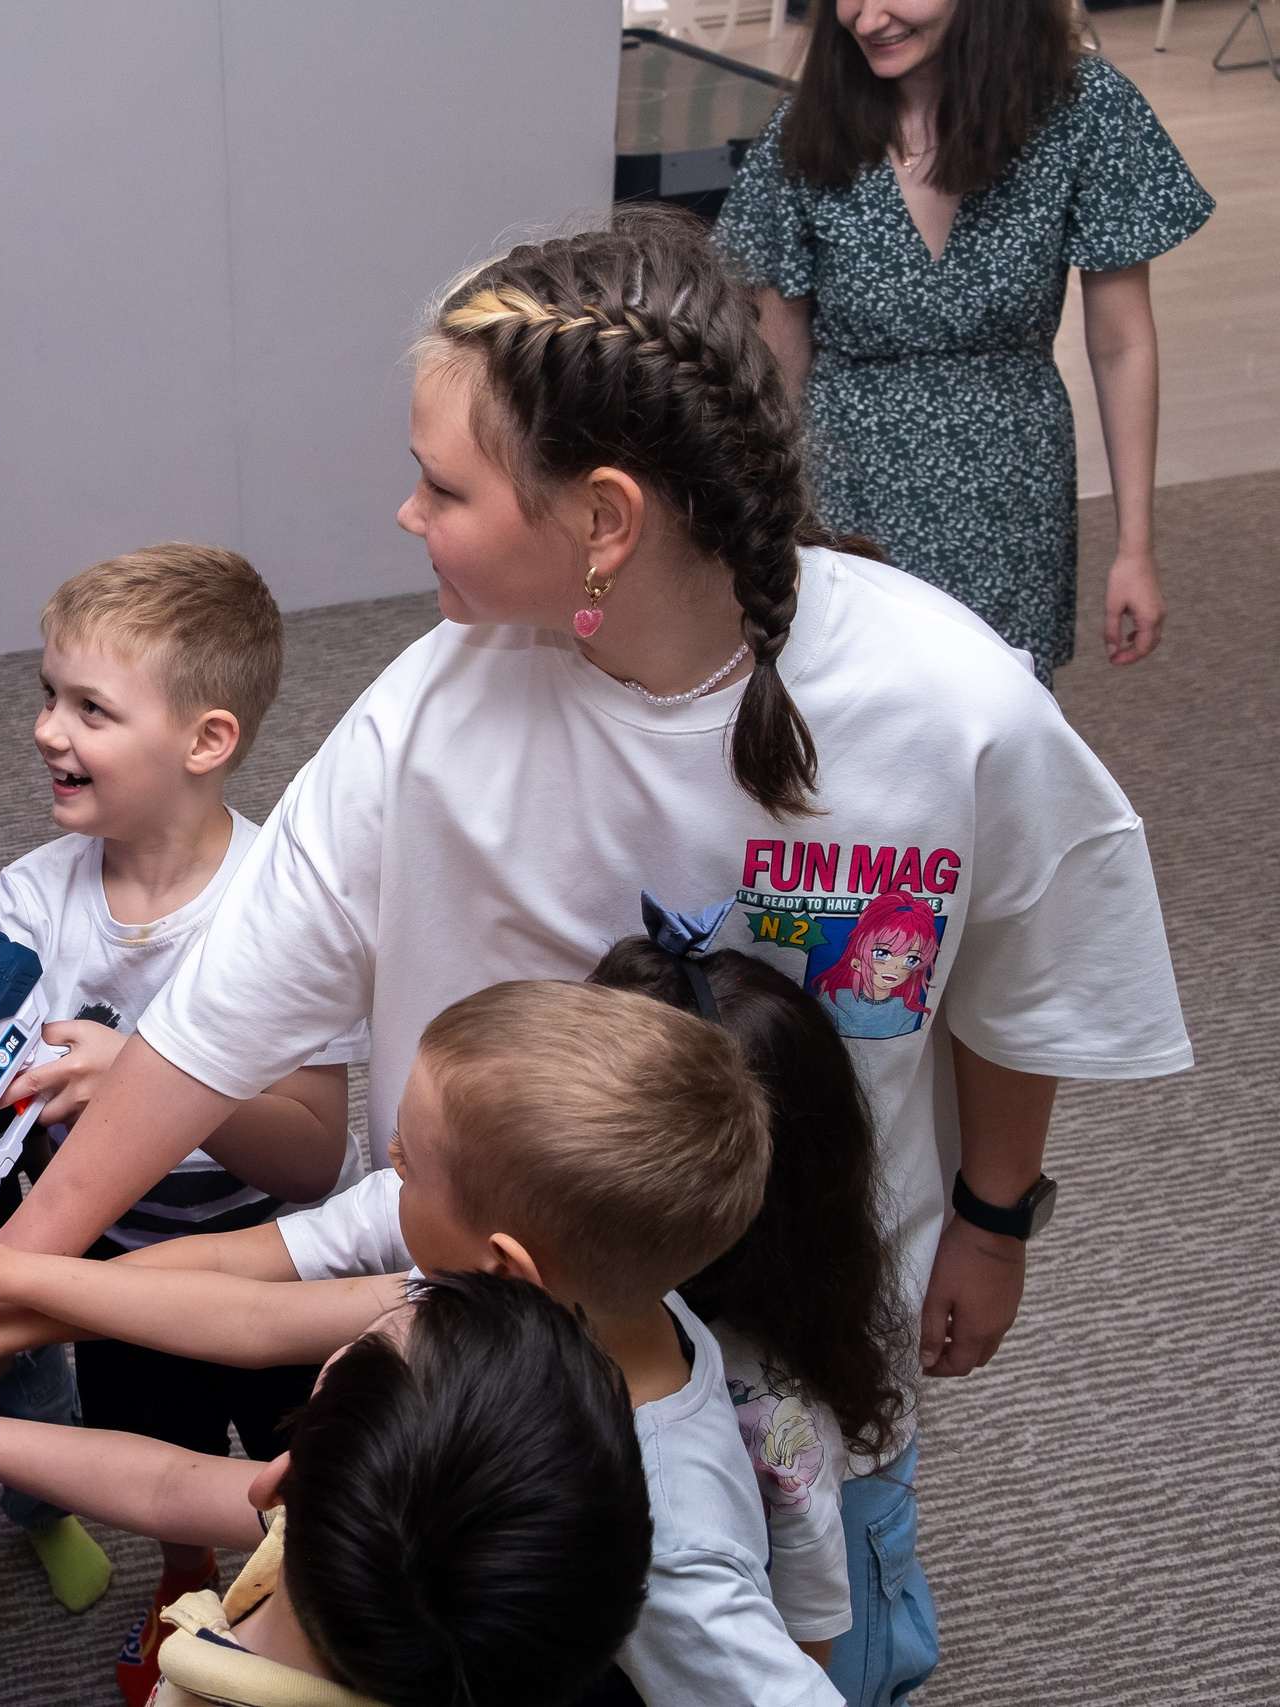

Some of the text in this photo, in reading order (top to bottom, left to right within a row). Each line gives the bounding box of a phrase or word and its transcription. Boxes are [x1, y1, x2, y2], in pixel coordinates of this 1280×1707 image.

[742, 840, 961, 895] FUN MAG
[738, 891, 758, 904] I'M
[762, 896, 802, 909] READY
[807, 898, 822, 910] TO
[826, 898, 857, 911] HAVE
[760, 915, 809, 945] N.2
